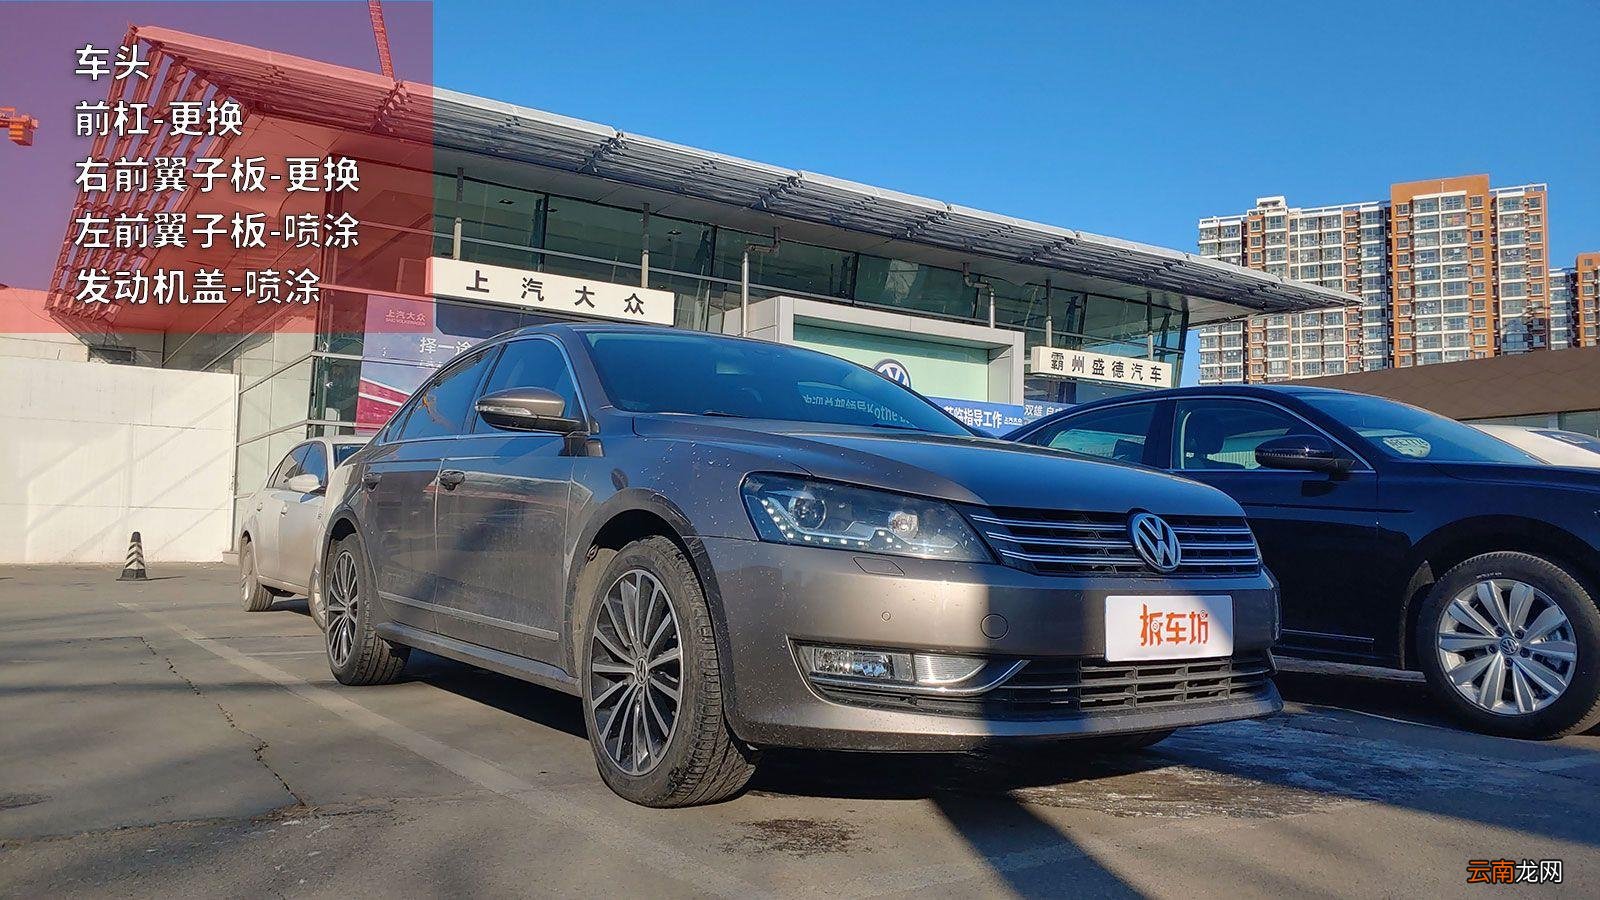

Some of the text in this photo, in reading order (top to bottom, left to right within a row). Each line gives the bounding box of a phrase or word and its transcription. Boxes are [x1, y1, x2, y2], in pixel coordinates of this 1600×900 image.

[465, 269, 645, 316] 上汽大众
[1050, 351, 1162, 383] 霸州盛德汽车
